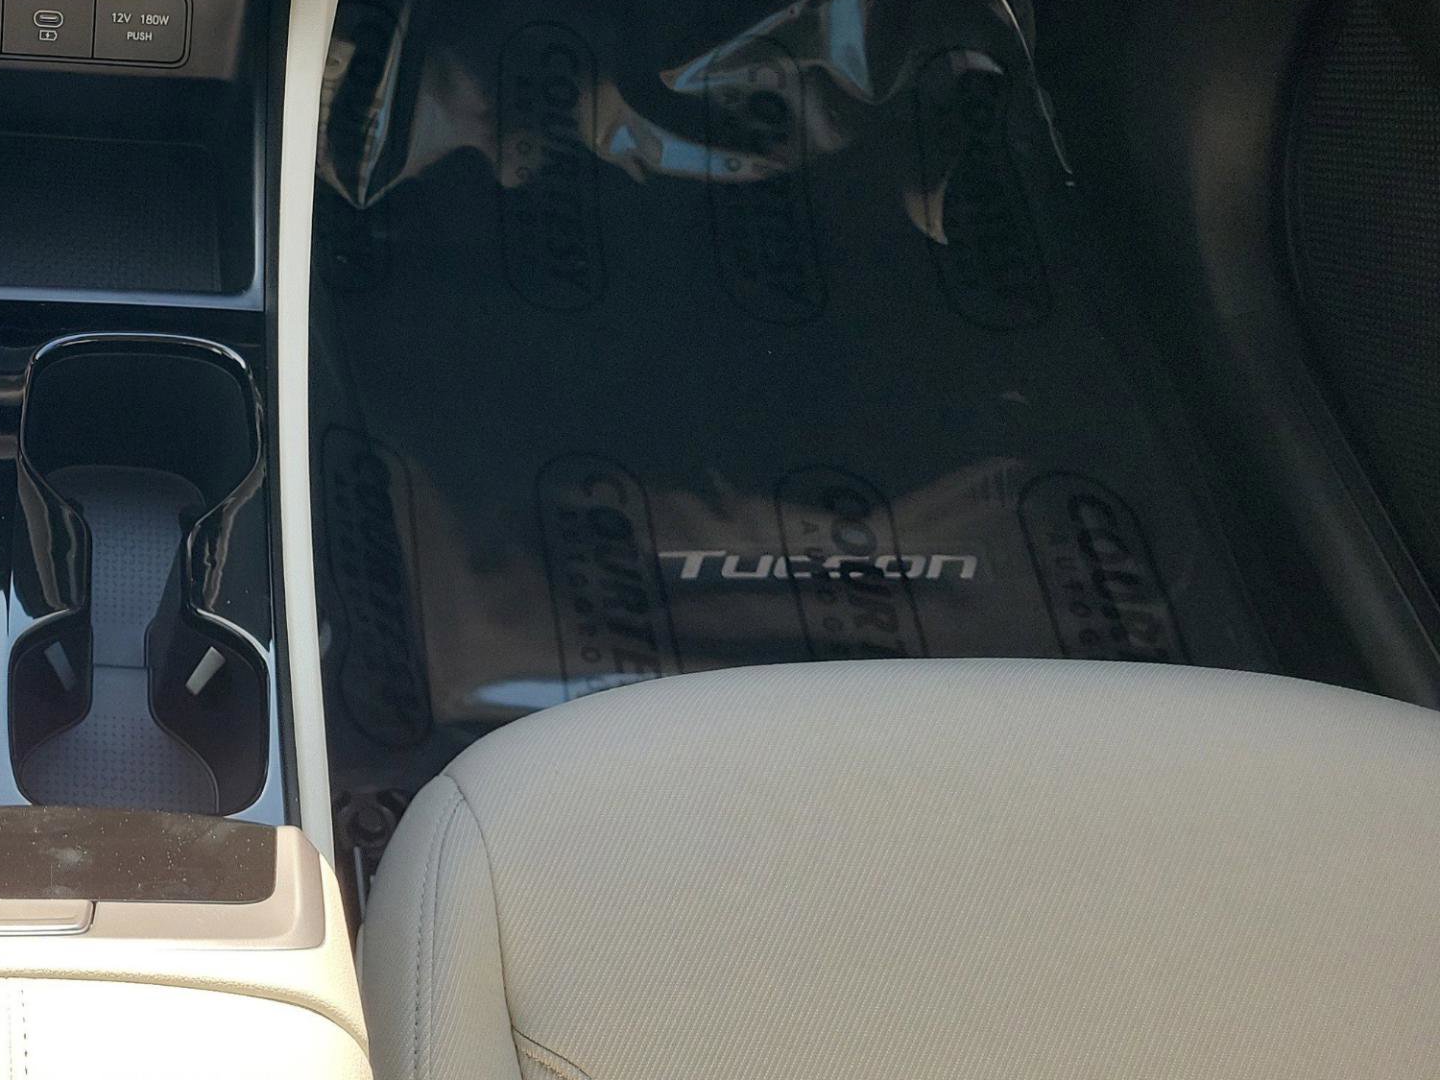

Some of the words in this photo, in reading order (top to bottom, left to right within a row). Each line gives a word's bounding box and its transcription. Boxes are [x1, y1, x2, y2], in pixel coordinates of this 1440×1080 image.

[112, 12, 131, 24] 12V
[140, 13, 170, 26] 180W
[127, 31, 152, 42] PUSH
